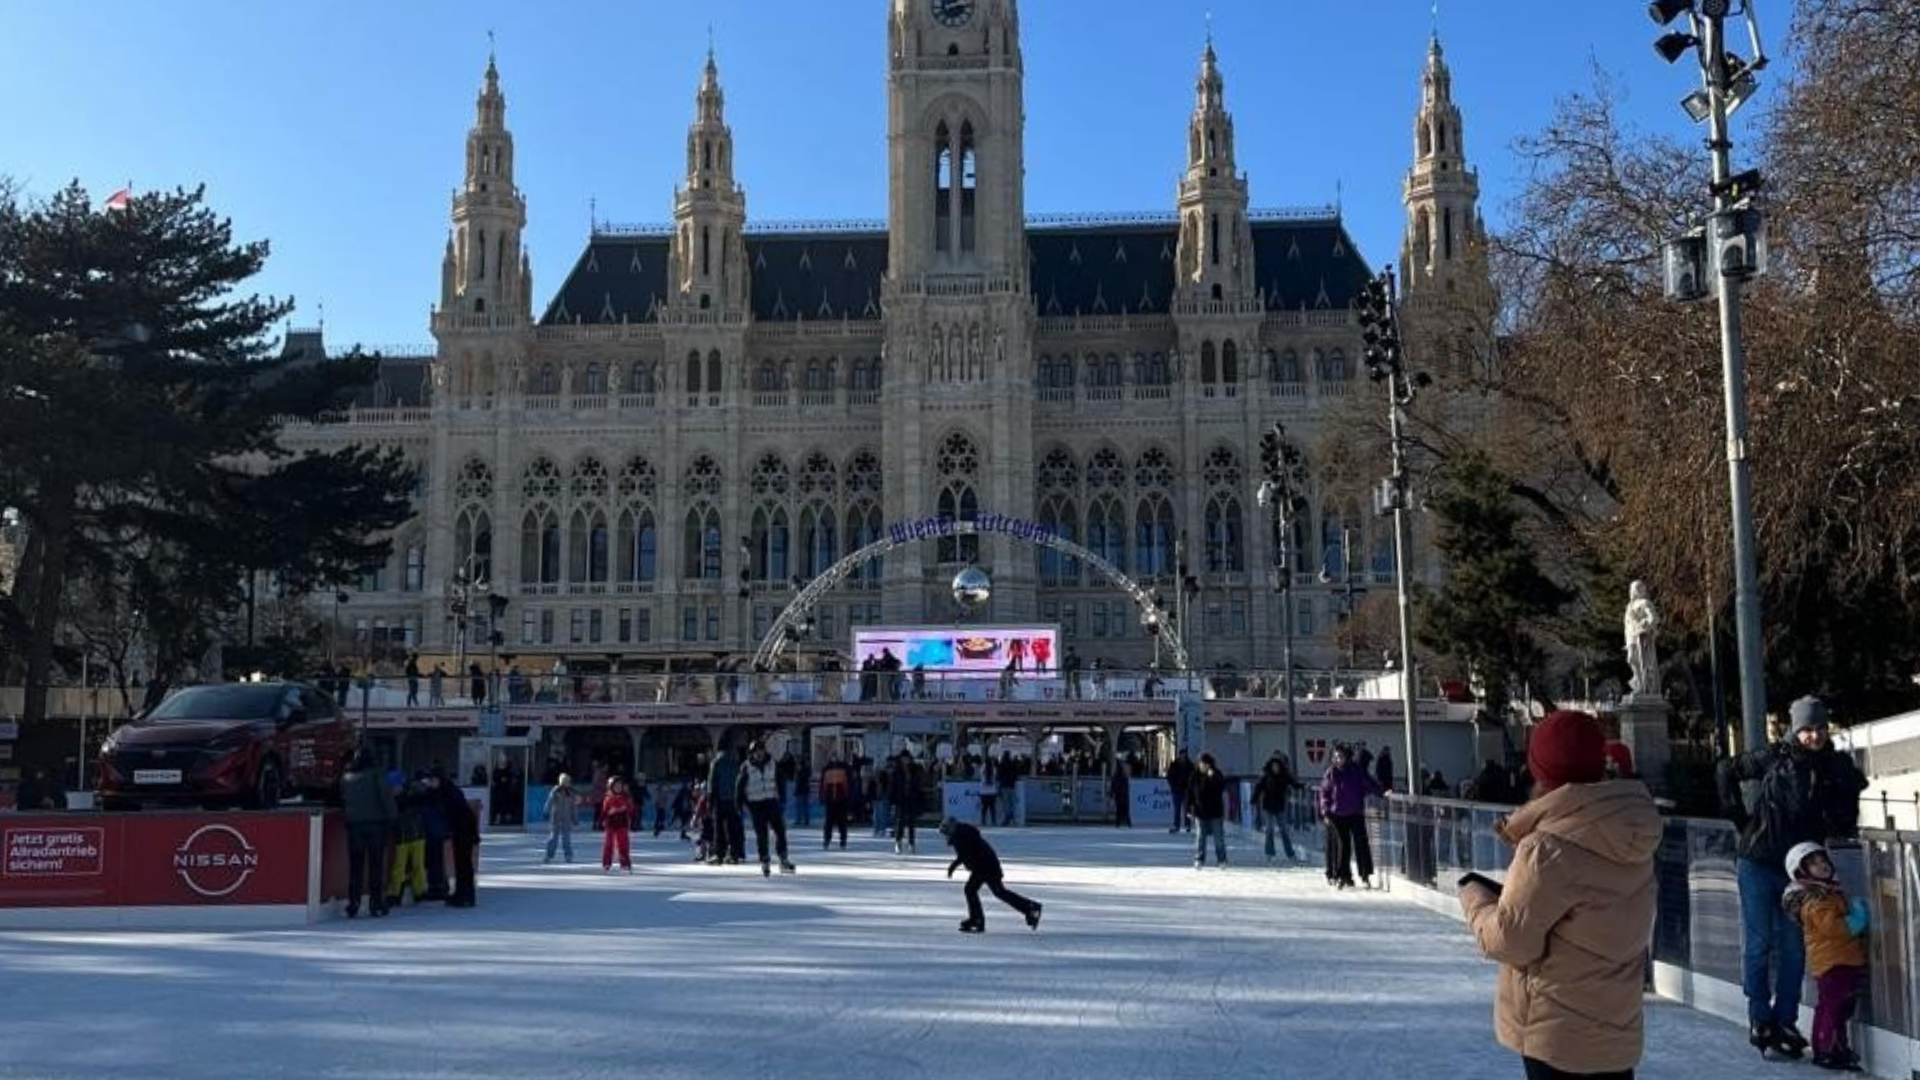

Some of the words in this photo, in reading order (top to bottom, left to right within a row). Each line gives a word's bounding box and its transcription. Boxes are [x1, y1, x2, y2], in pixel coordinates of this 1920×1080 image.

[10, 834, 43, 845] Jetzt
[45, 834, 84, 848] gratis
[10, 845, 97, 858] Allradantrieb
[10, 858, 63, 871] sichern!
[173, 854, 258, 867] NISSAN
